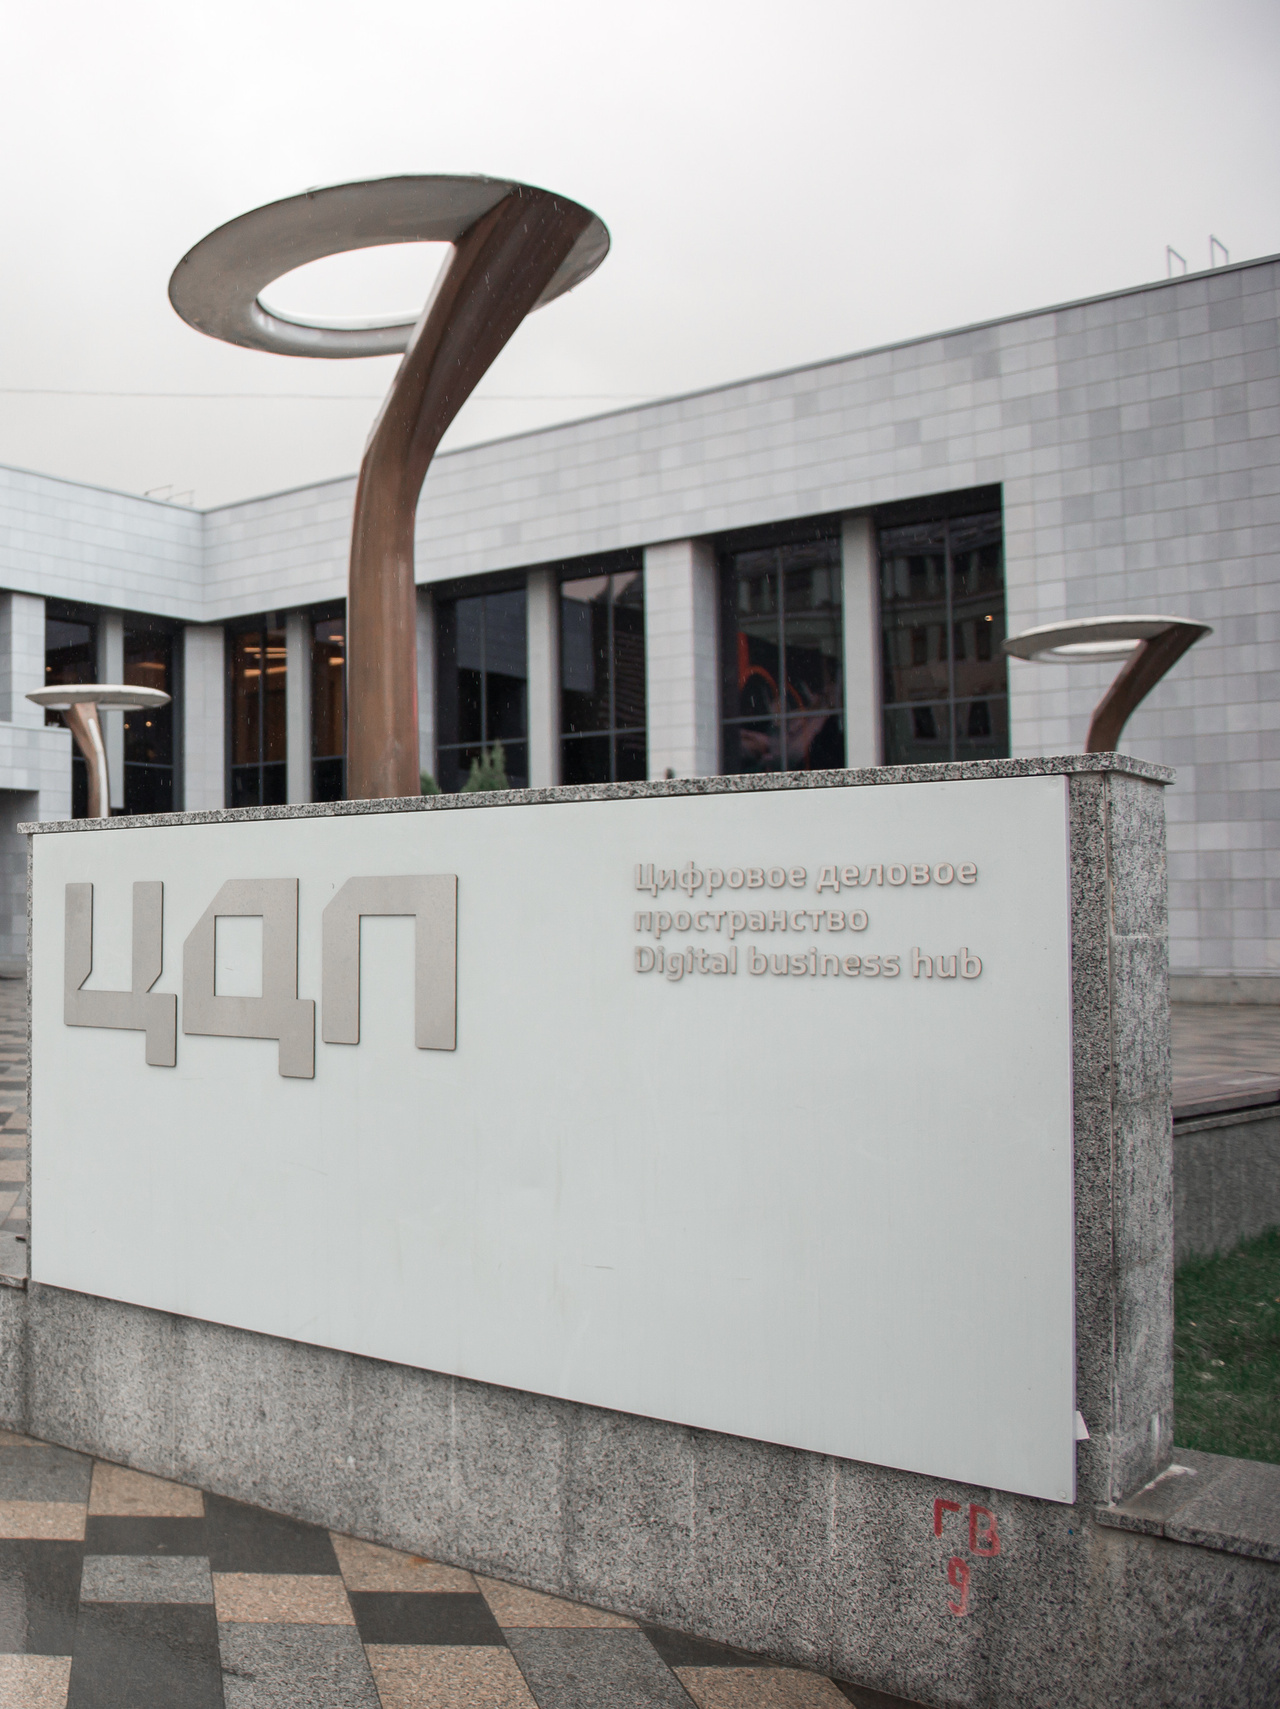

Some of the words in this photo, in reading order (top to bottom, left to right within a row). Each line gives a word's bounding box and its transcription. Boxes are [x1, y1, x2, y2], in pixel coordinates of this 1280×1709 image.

[634, 861, 808, 897] Цифровое
[816, 861, 978, 893] деловое
[634, 909, 869, 939] пространство
[64, 874, 458, 1079] ЦДП
[634, 945, 738, 981] Digital
[748, 946, 901, 977] business
[911, 947, 983, 979] hub
